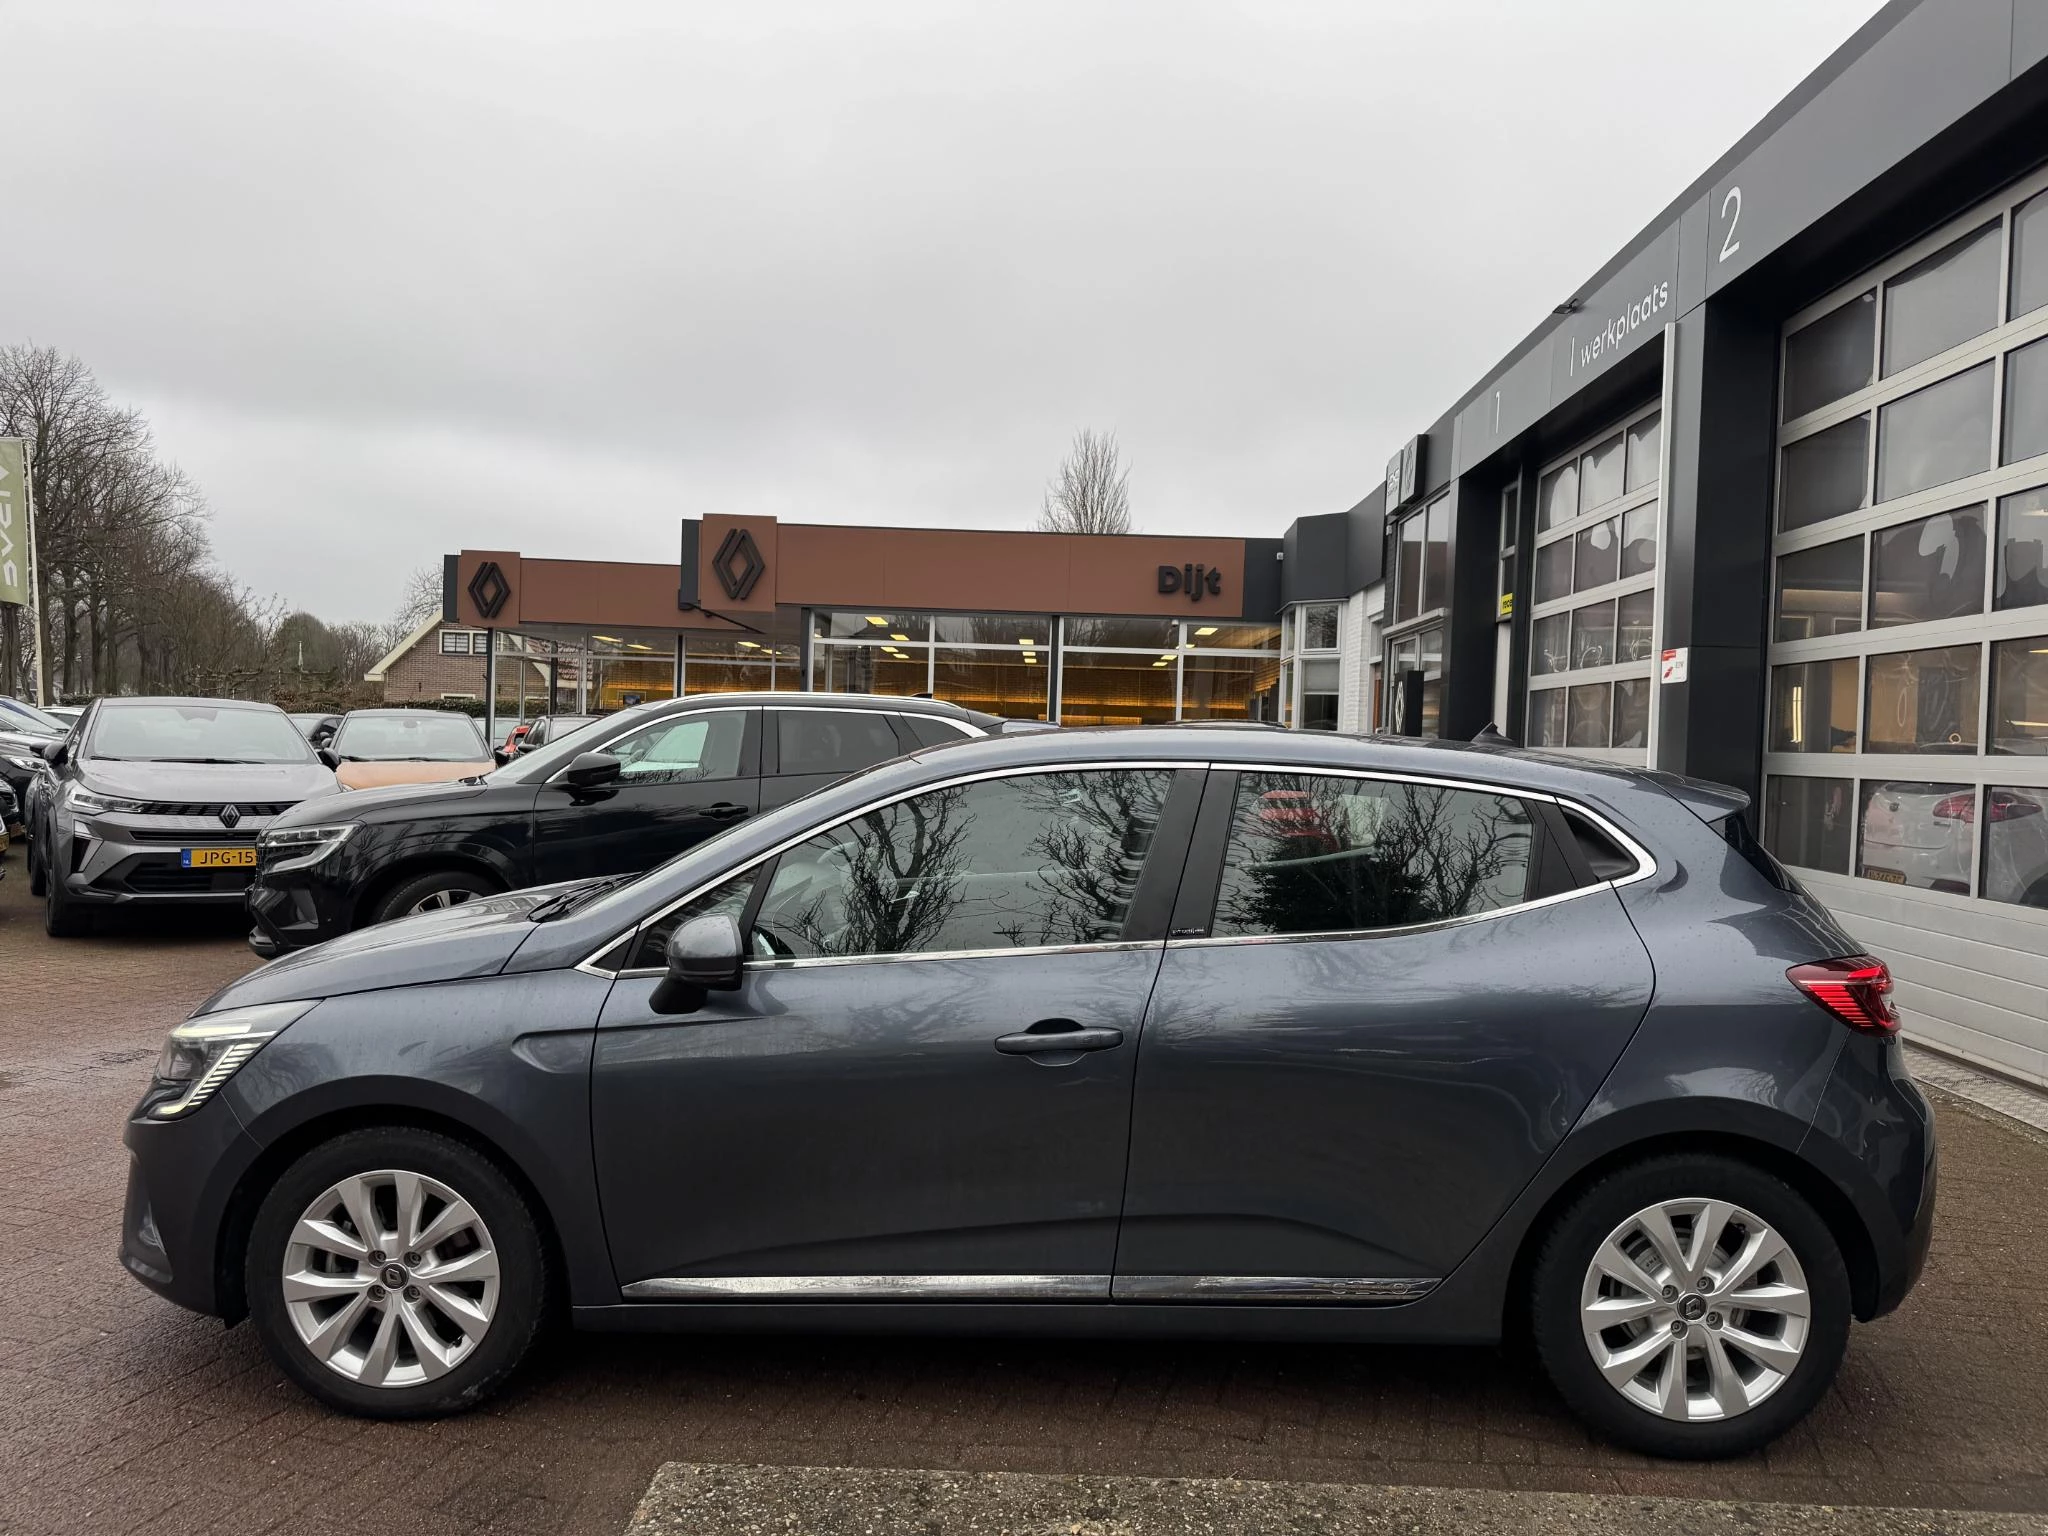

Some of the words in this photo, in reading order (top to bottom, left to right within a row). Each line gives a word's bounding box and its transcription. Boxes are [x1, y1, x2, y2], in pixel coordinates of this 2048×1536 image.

[1719, 186, 1741, 263] 2
[1581, 281, 1668, 368] werkplaats
[1158, 563, 1222, 603] Dijt
[200, 851, 257, 865] JPG-15
